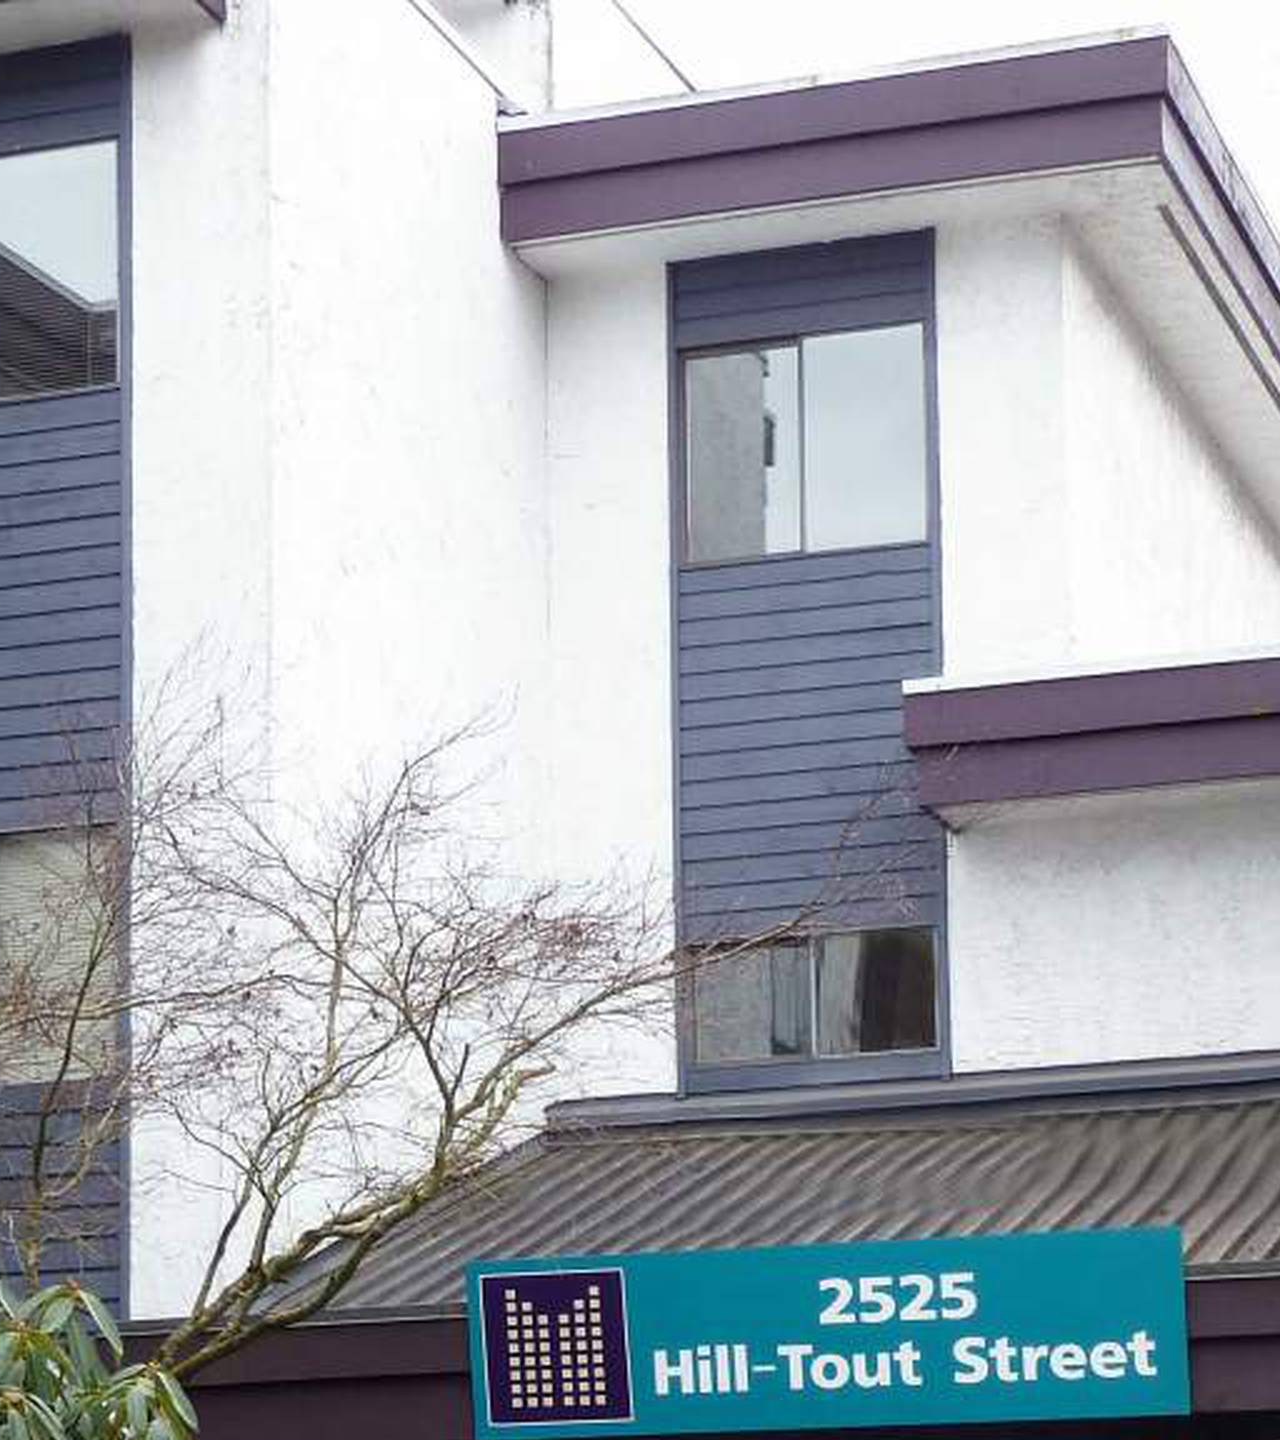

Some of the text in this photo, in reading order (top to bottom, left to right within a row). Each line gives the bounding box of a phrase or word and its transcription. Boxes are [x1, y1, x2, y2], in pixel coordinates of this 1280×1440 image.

[819, 1271, 978, 1325] 2525
[653, 1331, 1158, 1396] Hill-Tout Street
